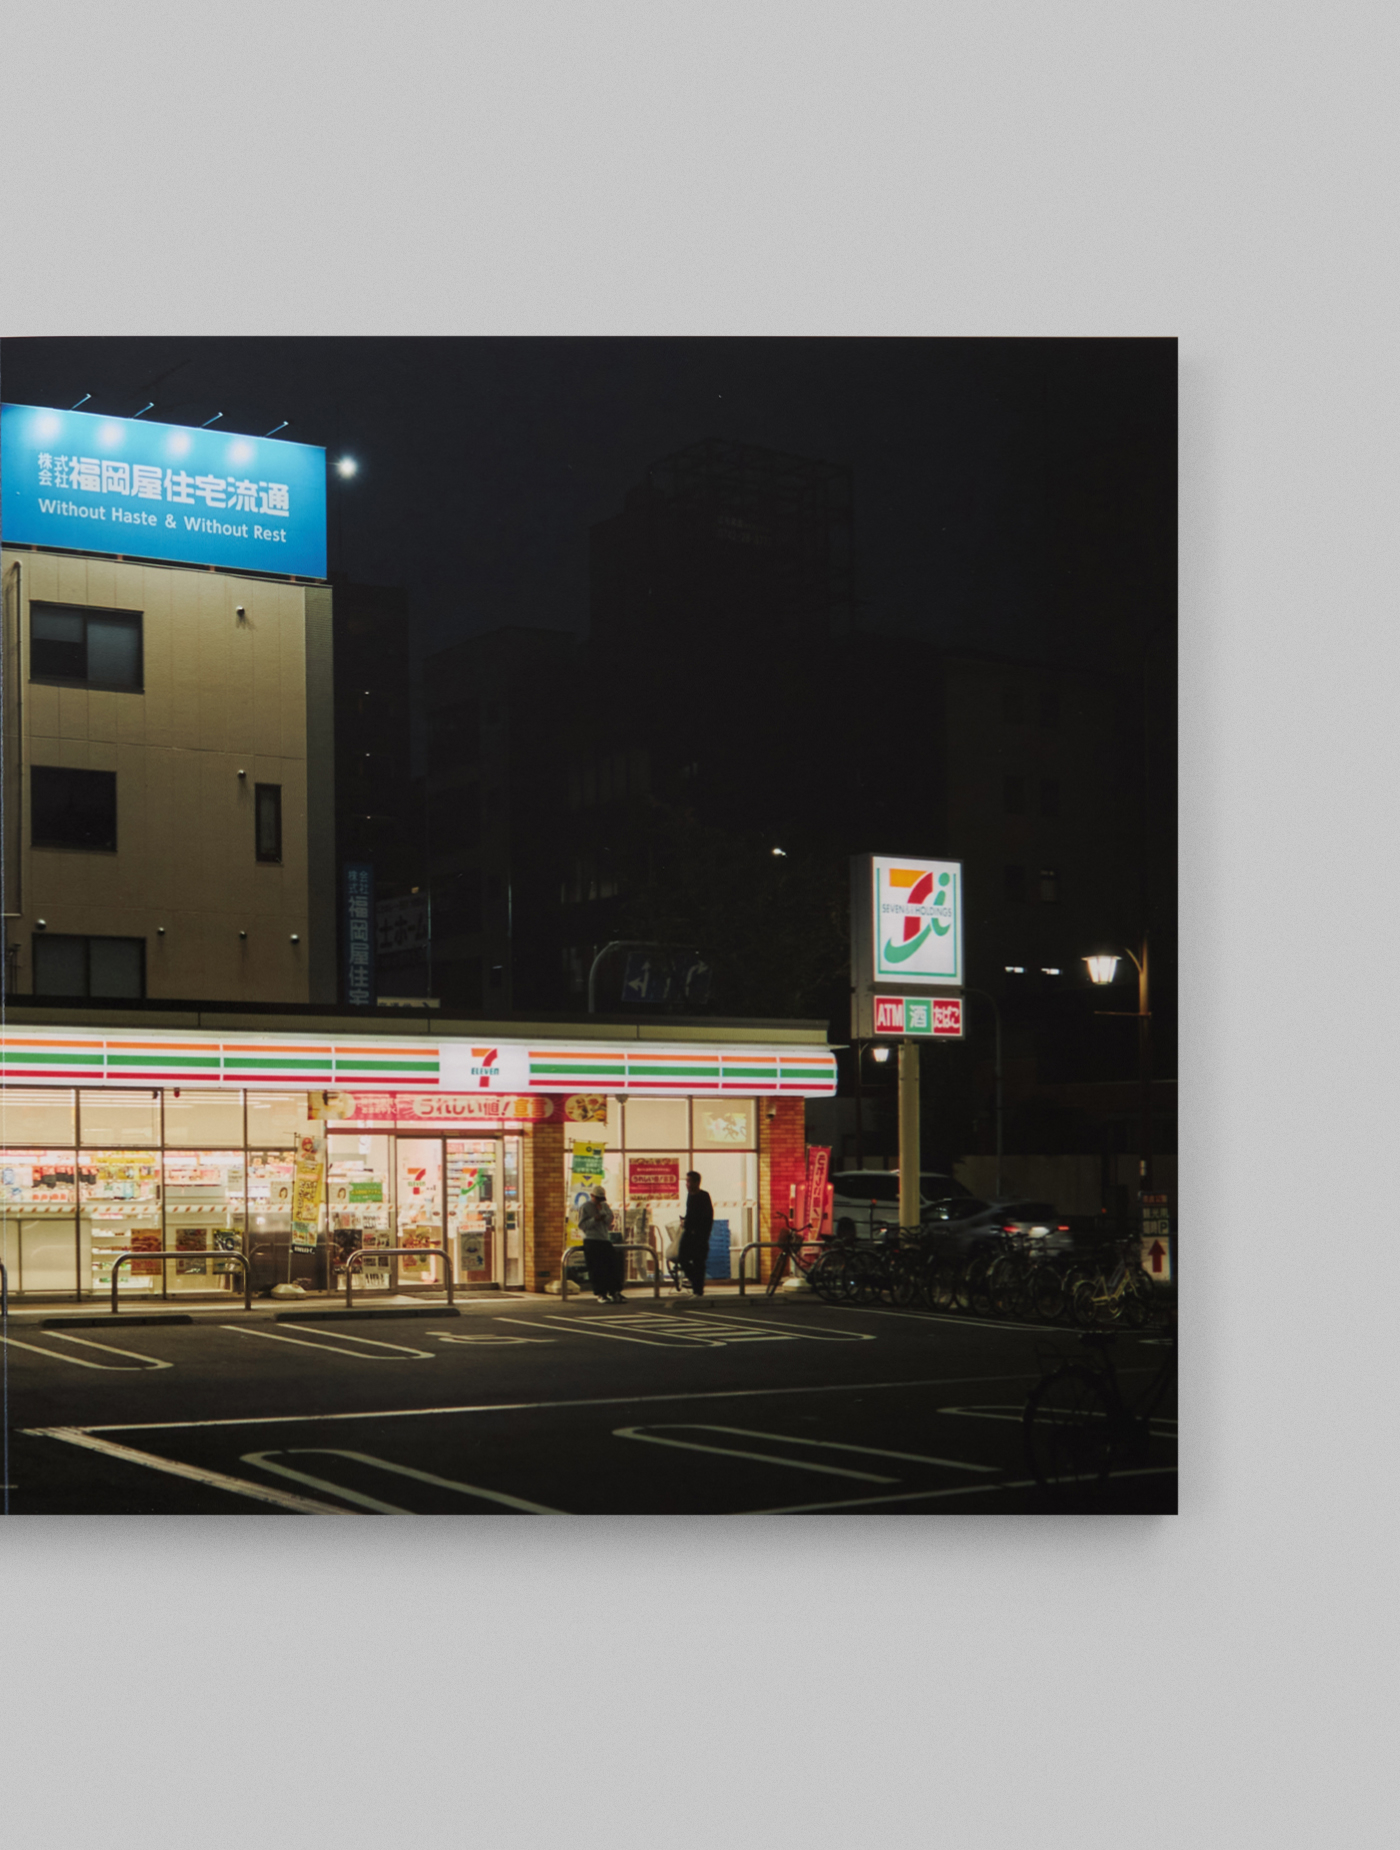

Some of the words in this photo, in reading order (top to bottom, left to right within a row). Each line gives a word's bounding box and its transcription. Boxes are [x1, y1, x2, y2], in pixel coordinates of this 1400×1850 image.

[68, 456, 290, 517] 福岡屋住宅流通
[37, 498, 106, 521] Without
[111, 507, 158, 527] Haste
[164, 514, 177, 529] &
[184, 516, 249, 538] Without
[254, 525, 287, 543] Rest
[878, 1004, 904, 1028] ATM
[909, 1005, 928, 1028] 酒
[933, 1005, 961, 1029] たばこ
